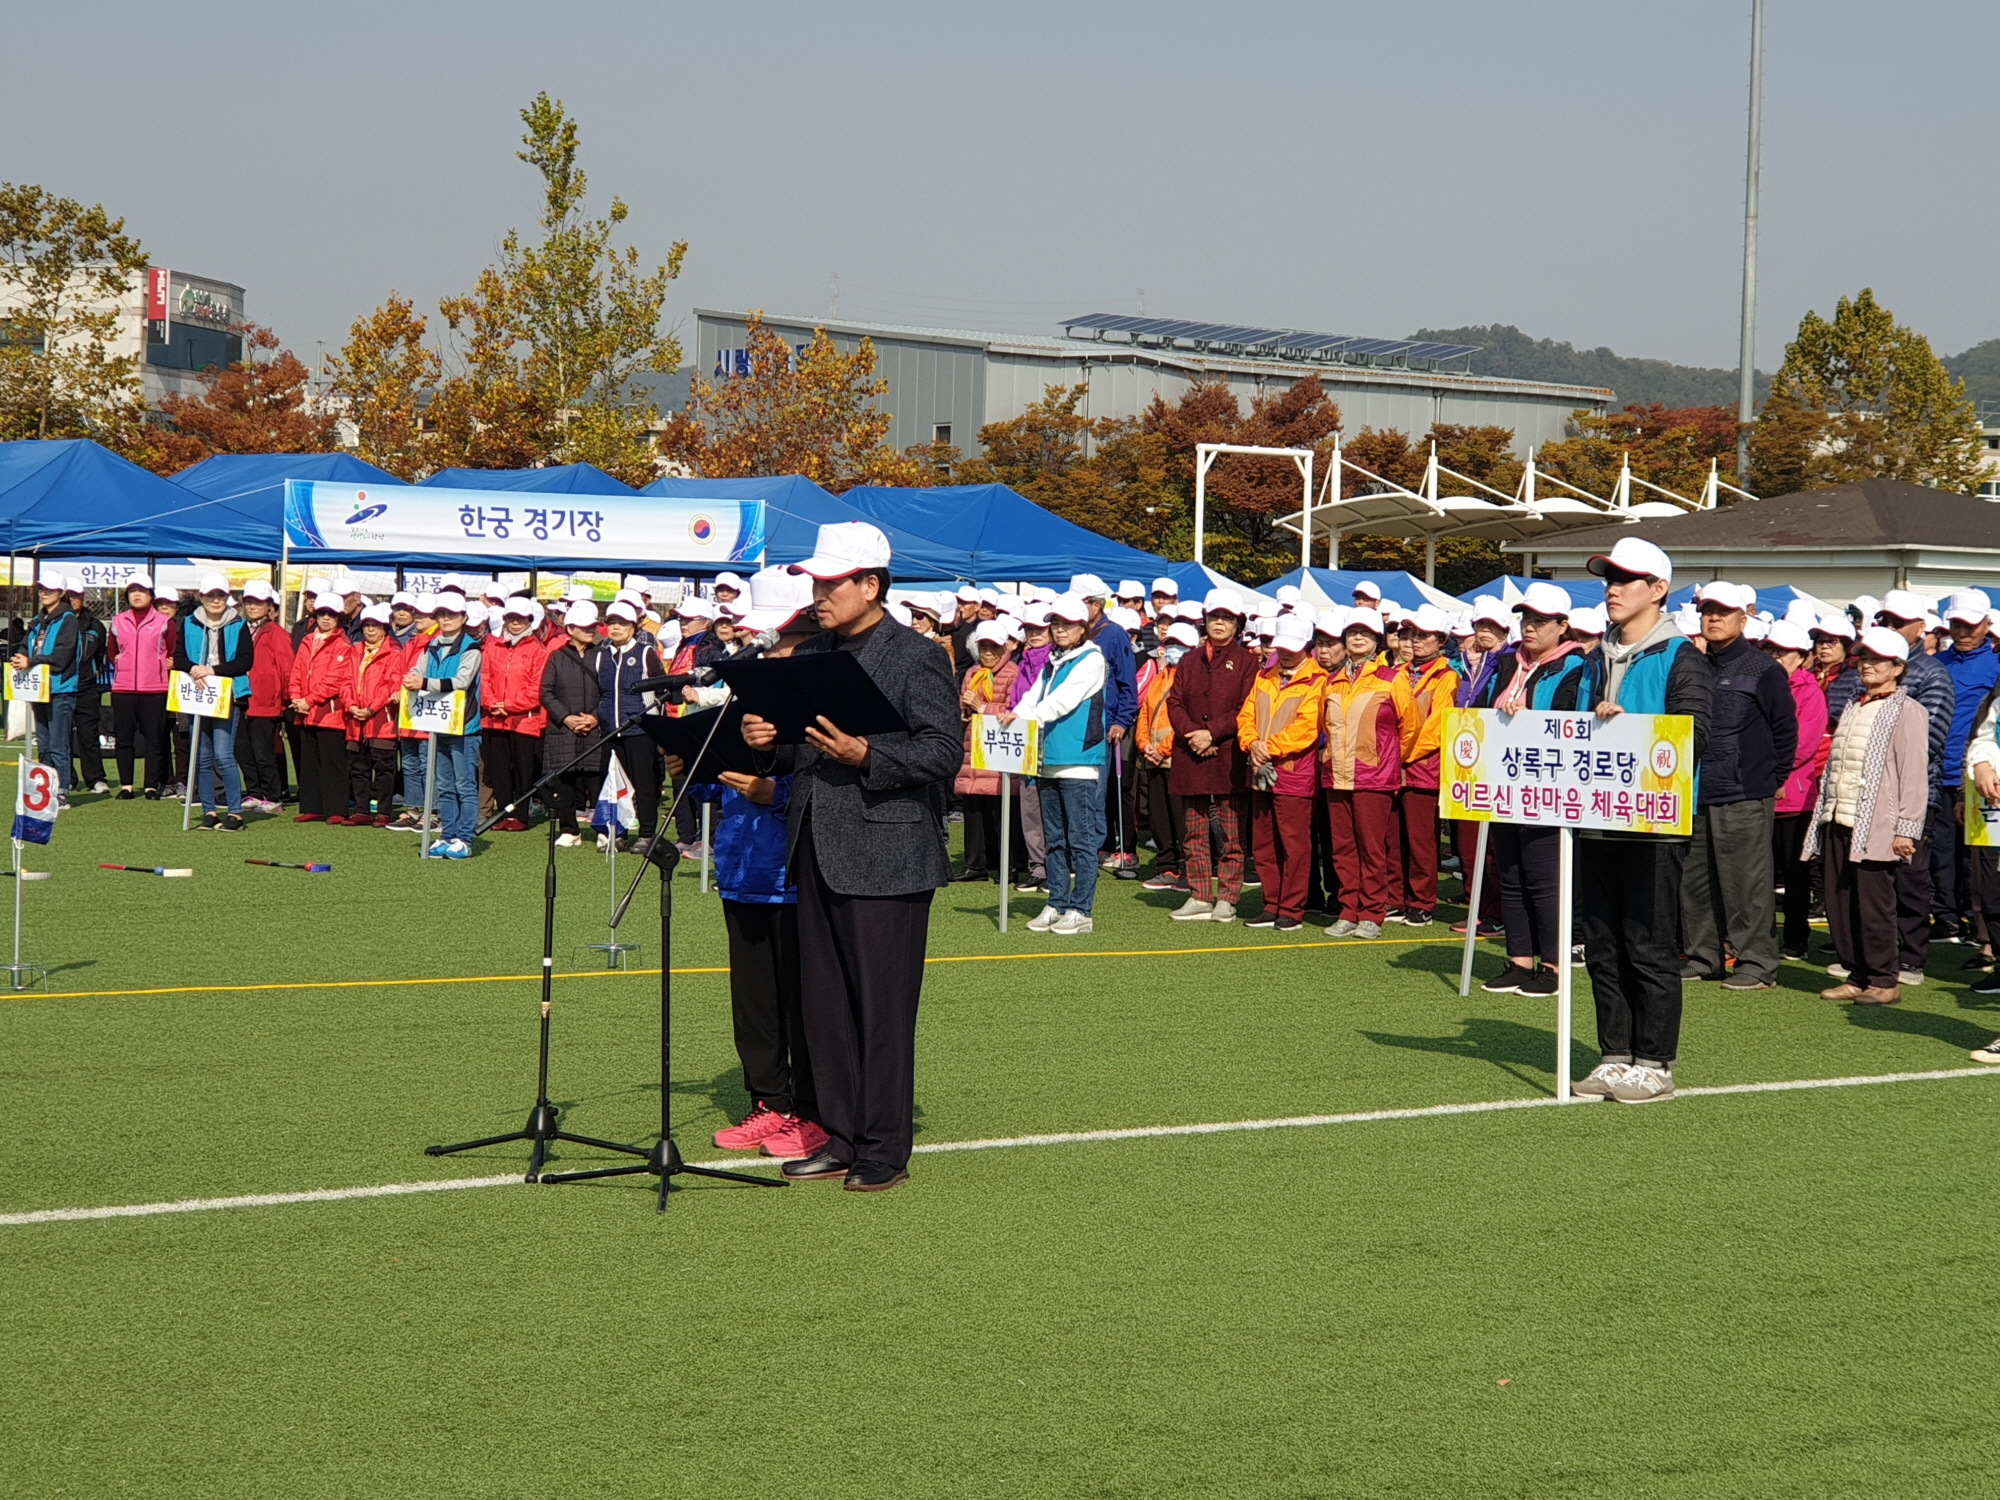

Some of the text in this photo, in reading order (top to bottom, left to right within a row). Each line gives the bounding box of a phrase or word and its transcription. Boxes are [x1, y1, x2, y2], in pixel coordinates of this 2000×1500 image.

[458, 504, 604, 543] 한궁 경기장
[12, 672, 41, 691] 안산동
[412, 697, 452, 720] 성포동
[984, 729, 1025, 757] 부곡동
[1543, 718, 1592, 742] 제6회
[1459, 739, 1474, 760] 慶
[1656, 748, 1672, 769] 祝
[1502, 746, 1636, 785] 상록구 경로당
[23, 767, 51, 811] 3
[1451, 782, 1679, 824] 어르신 한마음 체육대회
